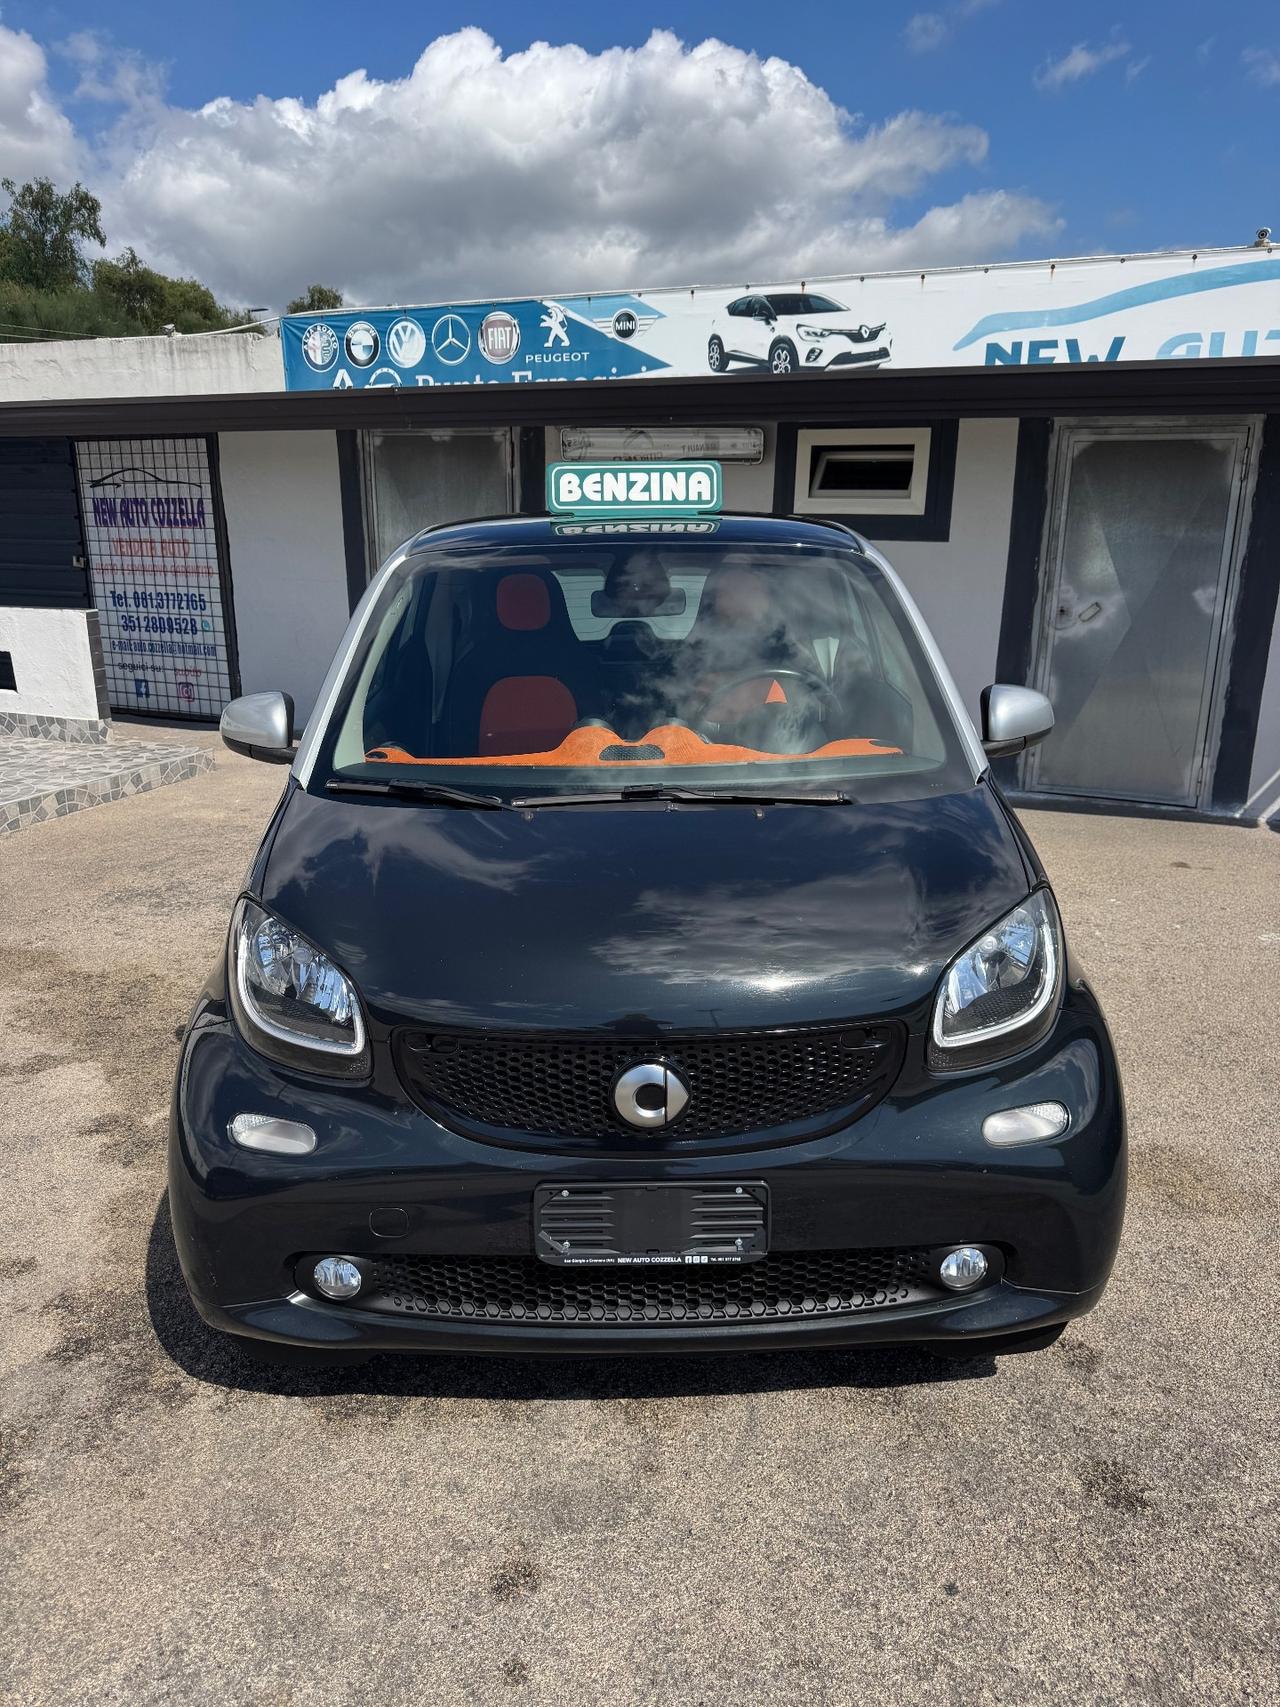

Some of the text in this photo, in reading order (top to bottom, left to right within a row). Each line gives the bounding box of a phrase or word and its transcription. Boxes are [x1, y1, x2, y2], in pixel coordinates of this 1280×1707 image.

[303, 325, 338, 350] ALFA ROMEO
[615, 320, 635, 331] MINI
[487, 326, 511, 350] FIAT
[525, 351, 590, 364] PEUGEOT
[559, 471, 711, 503] BENZINA
[92, 498, 206, 529] NEW AUTO COZZELLA
[111, 591, 131, 608] Tel.
